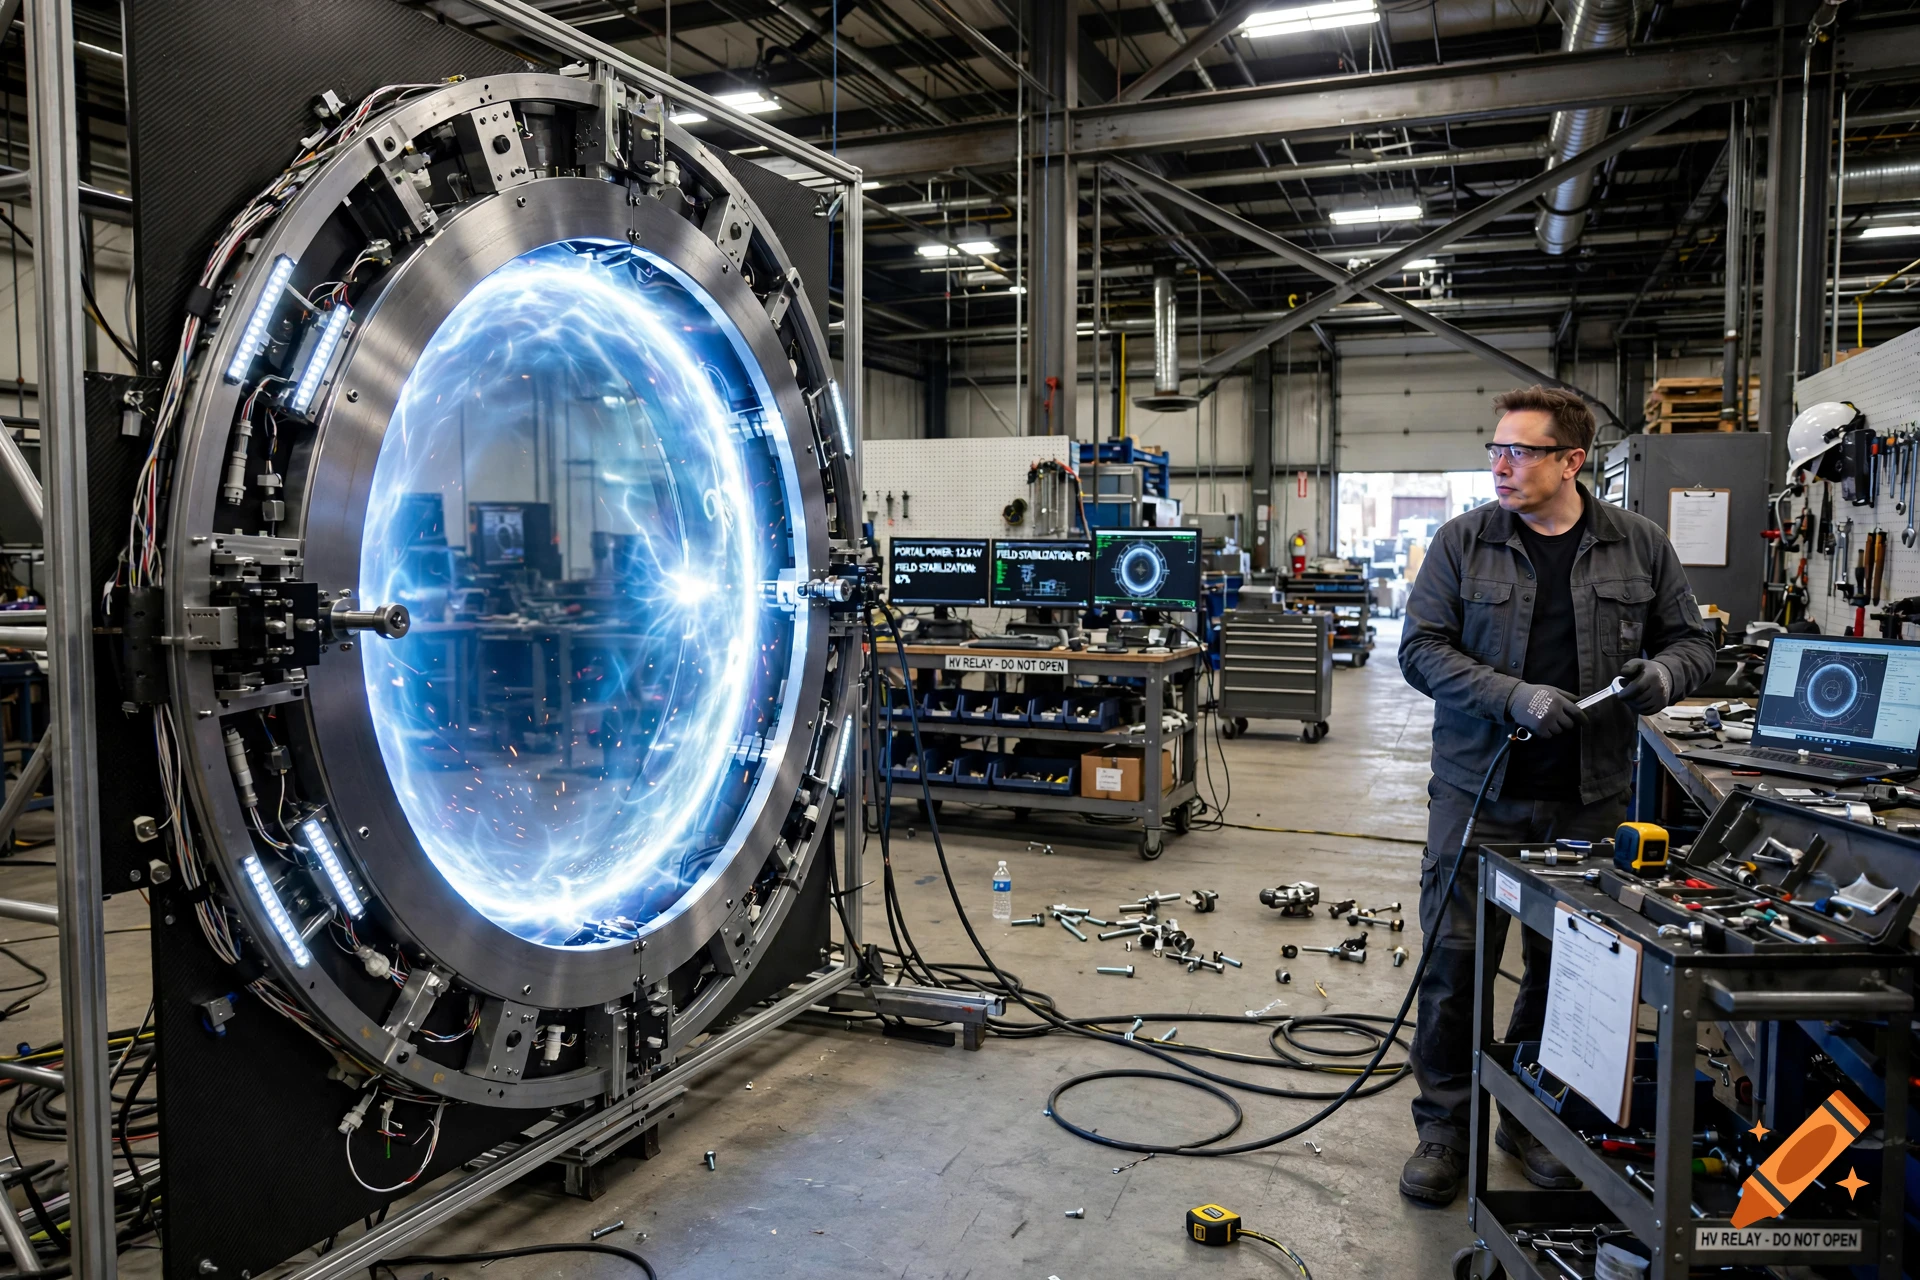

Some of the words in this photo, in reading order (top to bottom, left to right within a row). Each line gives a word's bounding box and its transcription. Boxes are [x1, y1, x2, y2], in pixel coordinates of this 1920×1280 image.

[894, 546, 925, 557] PORTAL
[996, 549, 1018, 560] FIELD
[894, 562, 918, 573] FIELD
[949, 657, 961, 667] HV
[963, 657, 993, 669] RELAY
[1001, 659, 1015, 670] DO
[1017, 659, 1037, 671] NOT
[1039, 660, 1064, 672] OPEN
[1701, 1232, 1718, 1246] HV
[1721, 1232, 1762, 1246] RELAY
[1773, 1232, 1791, 1246] DO
[1794, 1232, 1820, 1247] NOT
[1823, 1232, 1857, 1247] OPEN
